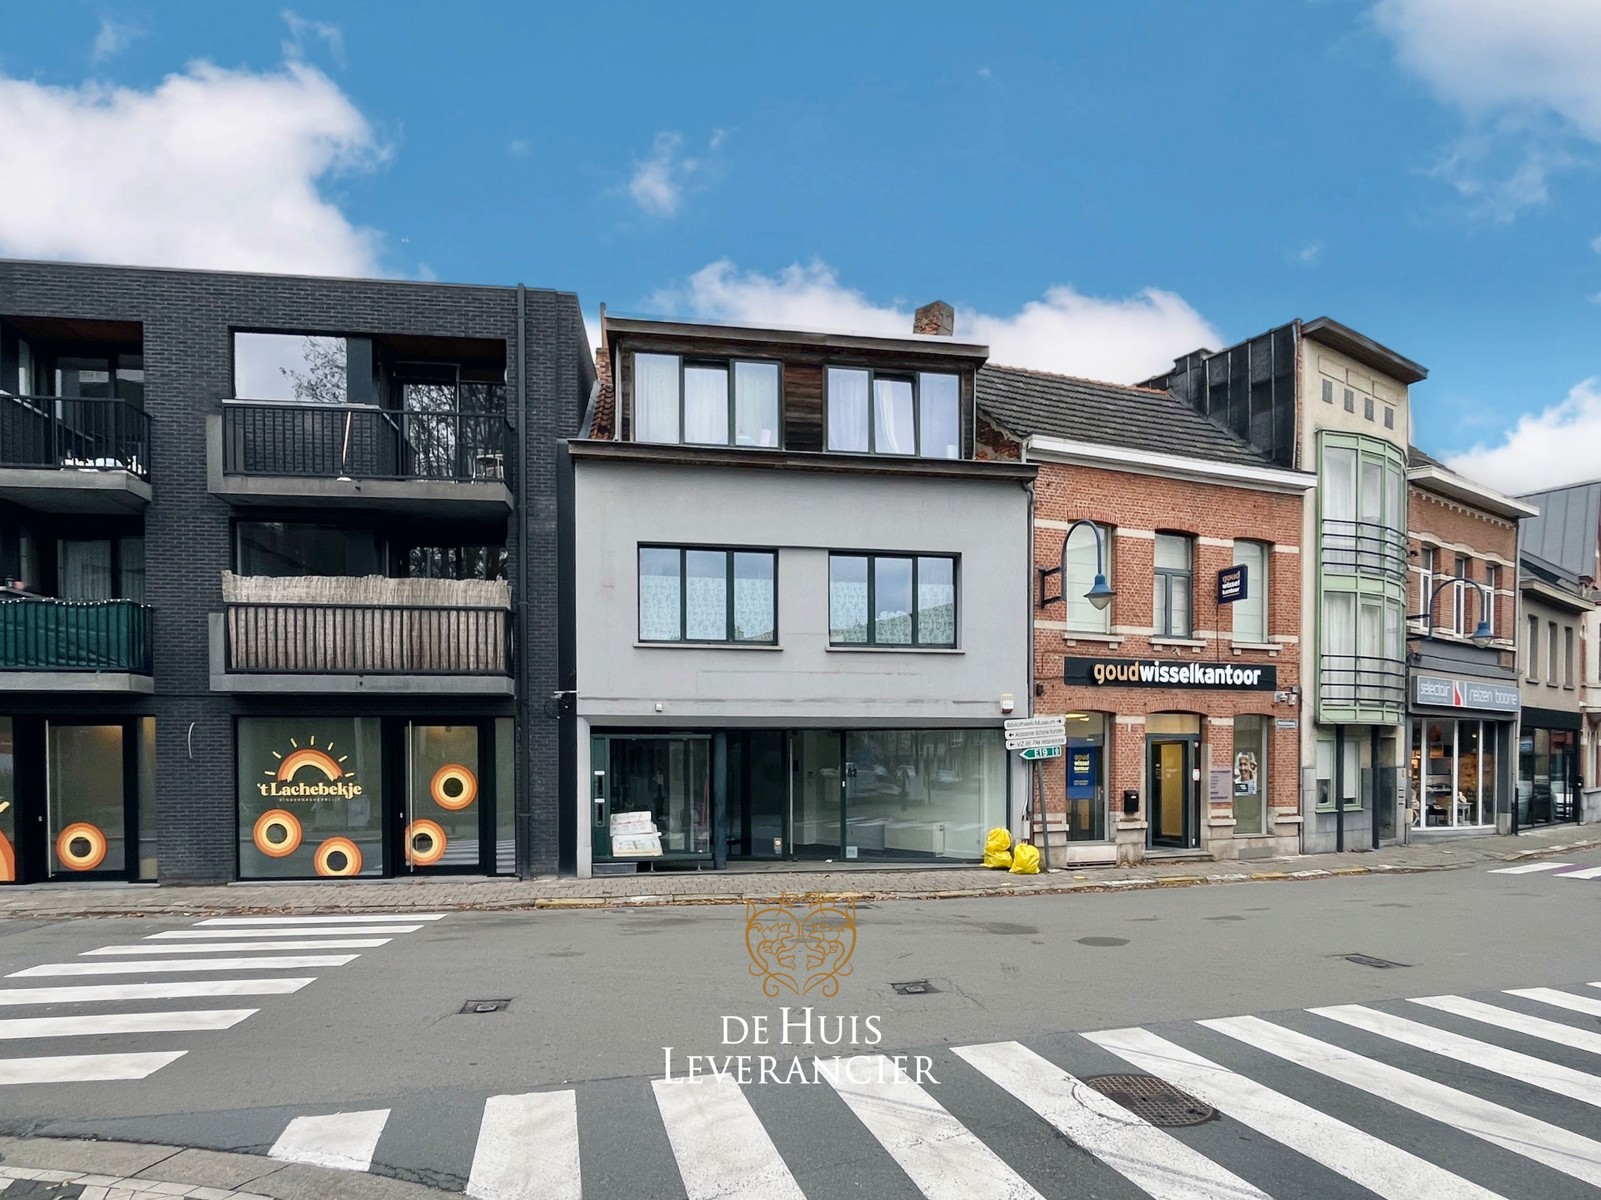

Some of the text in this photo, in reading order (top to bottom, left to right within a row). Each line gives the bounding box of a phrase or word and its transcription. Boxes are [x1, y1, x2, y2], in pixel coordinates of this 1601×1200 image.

[1094, 660, 1261, 685] goudwisselkantoor
[1034, 748, 1048, 758] E19
[270, 782, 362, 799] Lachebekje
